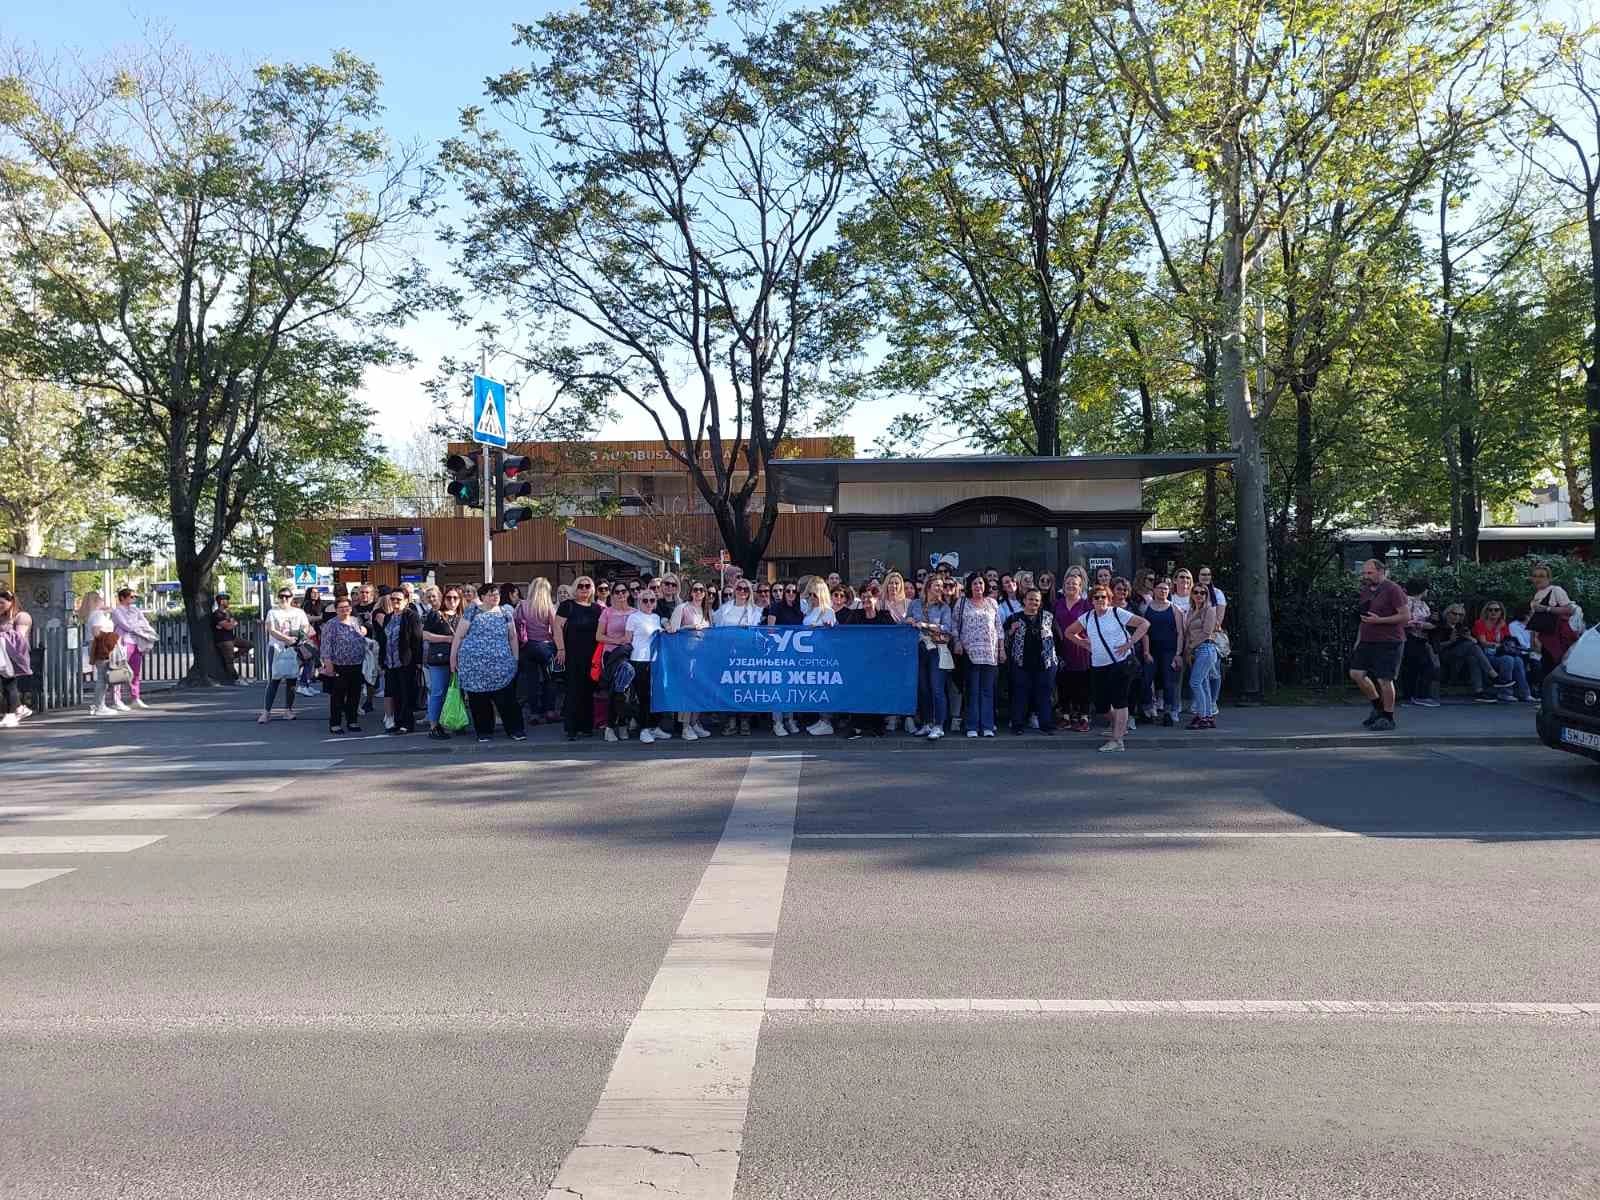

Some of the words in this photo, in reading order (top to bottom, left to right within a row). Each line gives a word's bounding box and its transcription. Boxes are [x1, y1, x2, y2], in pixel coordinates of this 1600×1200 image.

[769, 630, 814, 653] УС
[729, 657, 796, 667] УЈЕДИЊЕНА
[799, 658, 840, 667] СРПСКА
[720, 670, 783, 684] АКТИВ
[787, 671, 843, 685] ЖЕНА
[734, 689, 782, 703] БАЊА
[787, 689, 830, 703] ЛУКА
